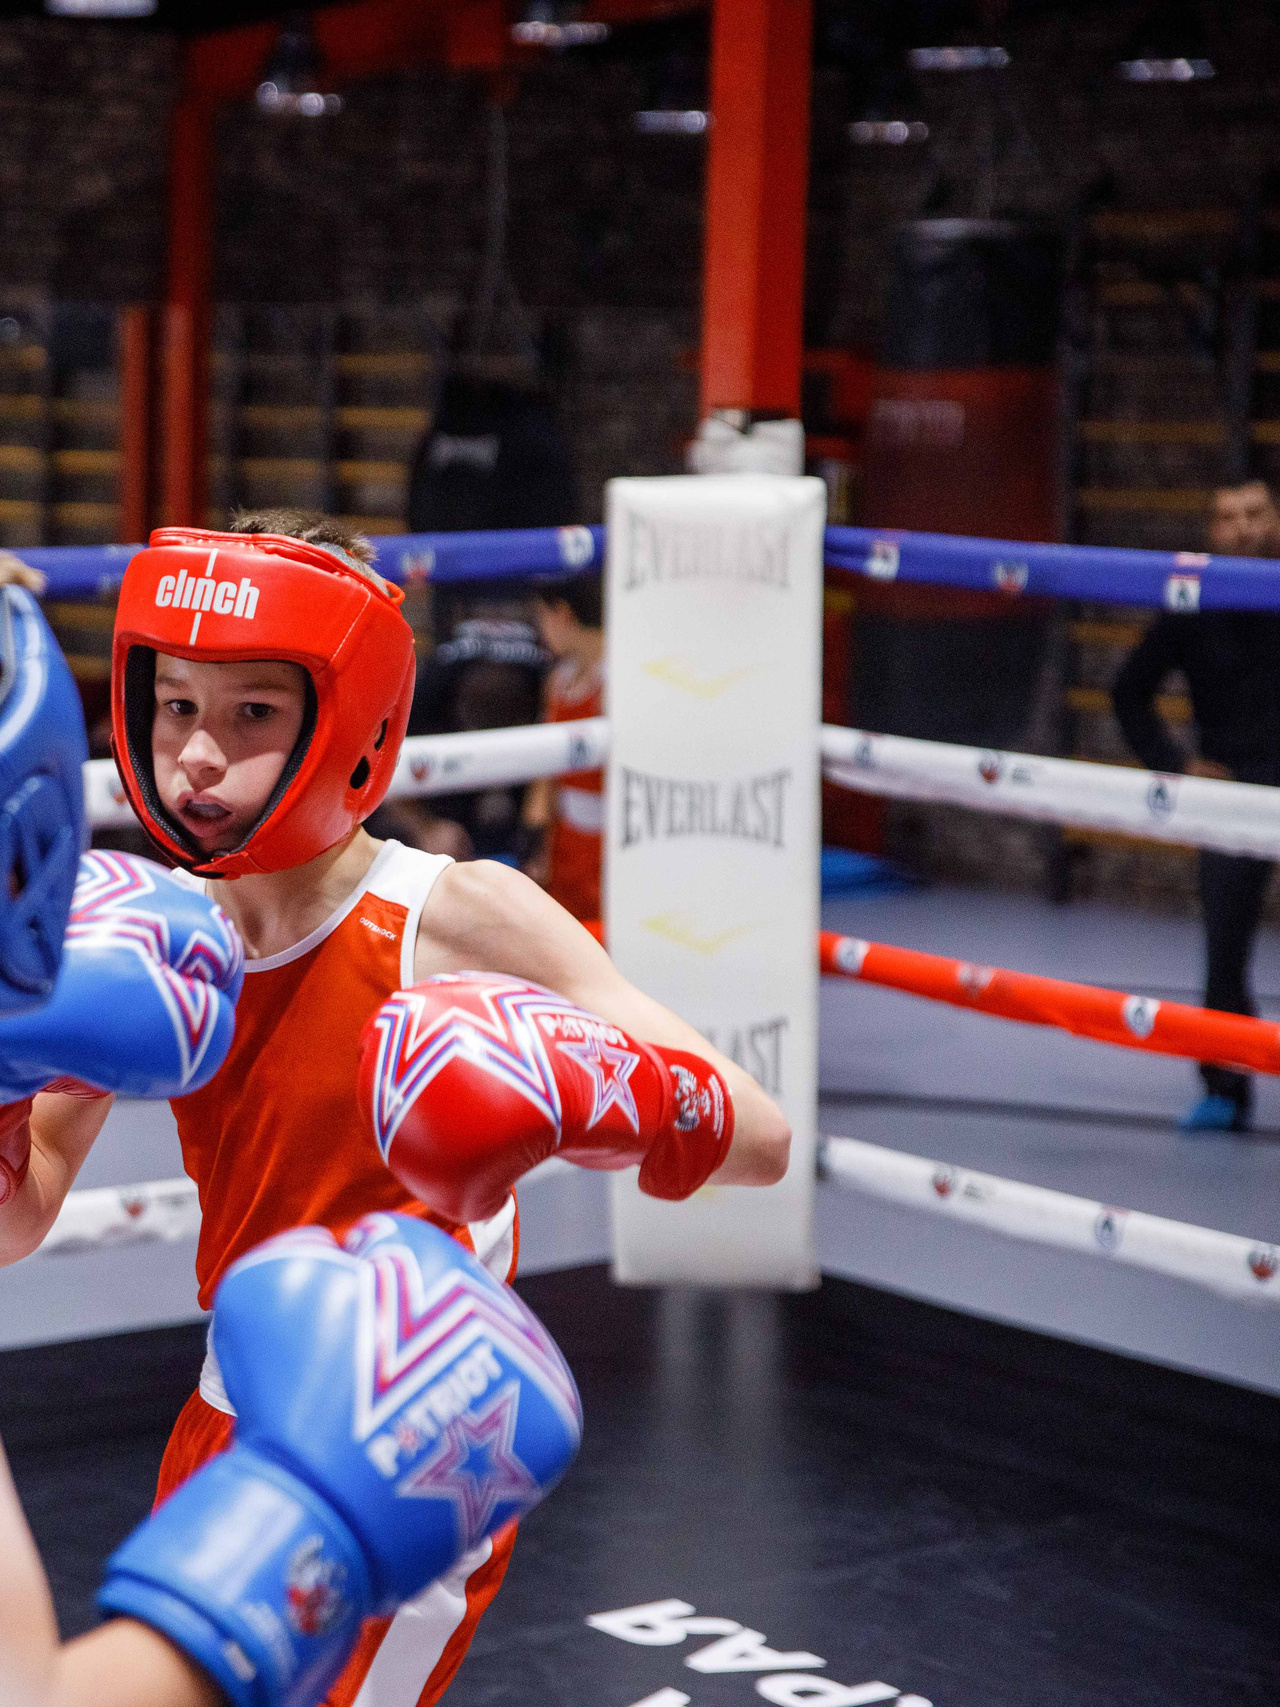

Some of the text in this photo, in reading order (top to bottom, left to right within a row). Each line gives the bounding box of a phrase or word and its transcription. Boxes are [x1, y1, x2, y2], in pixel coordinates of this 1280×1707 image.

[155, 569, 260, 619] clinch
[620, 764, 791, 849] EVERLAST
[584, 1598, 933, 1707] РАЯ
